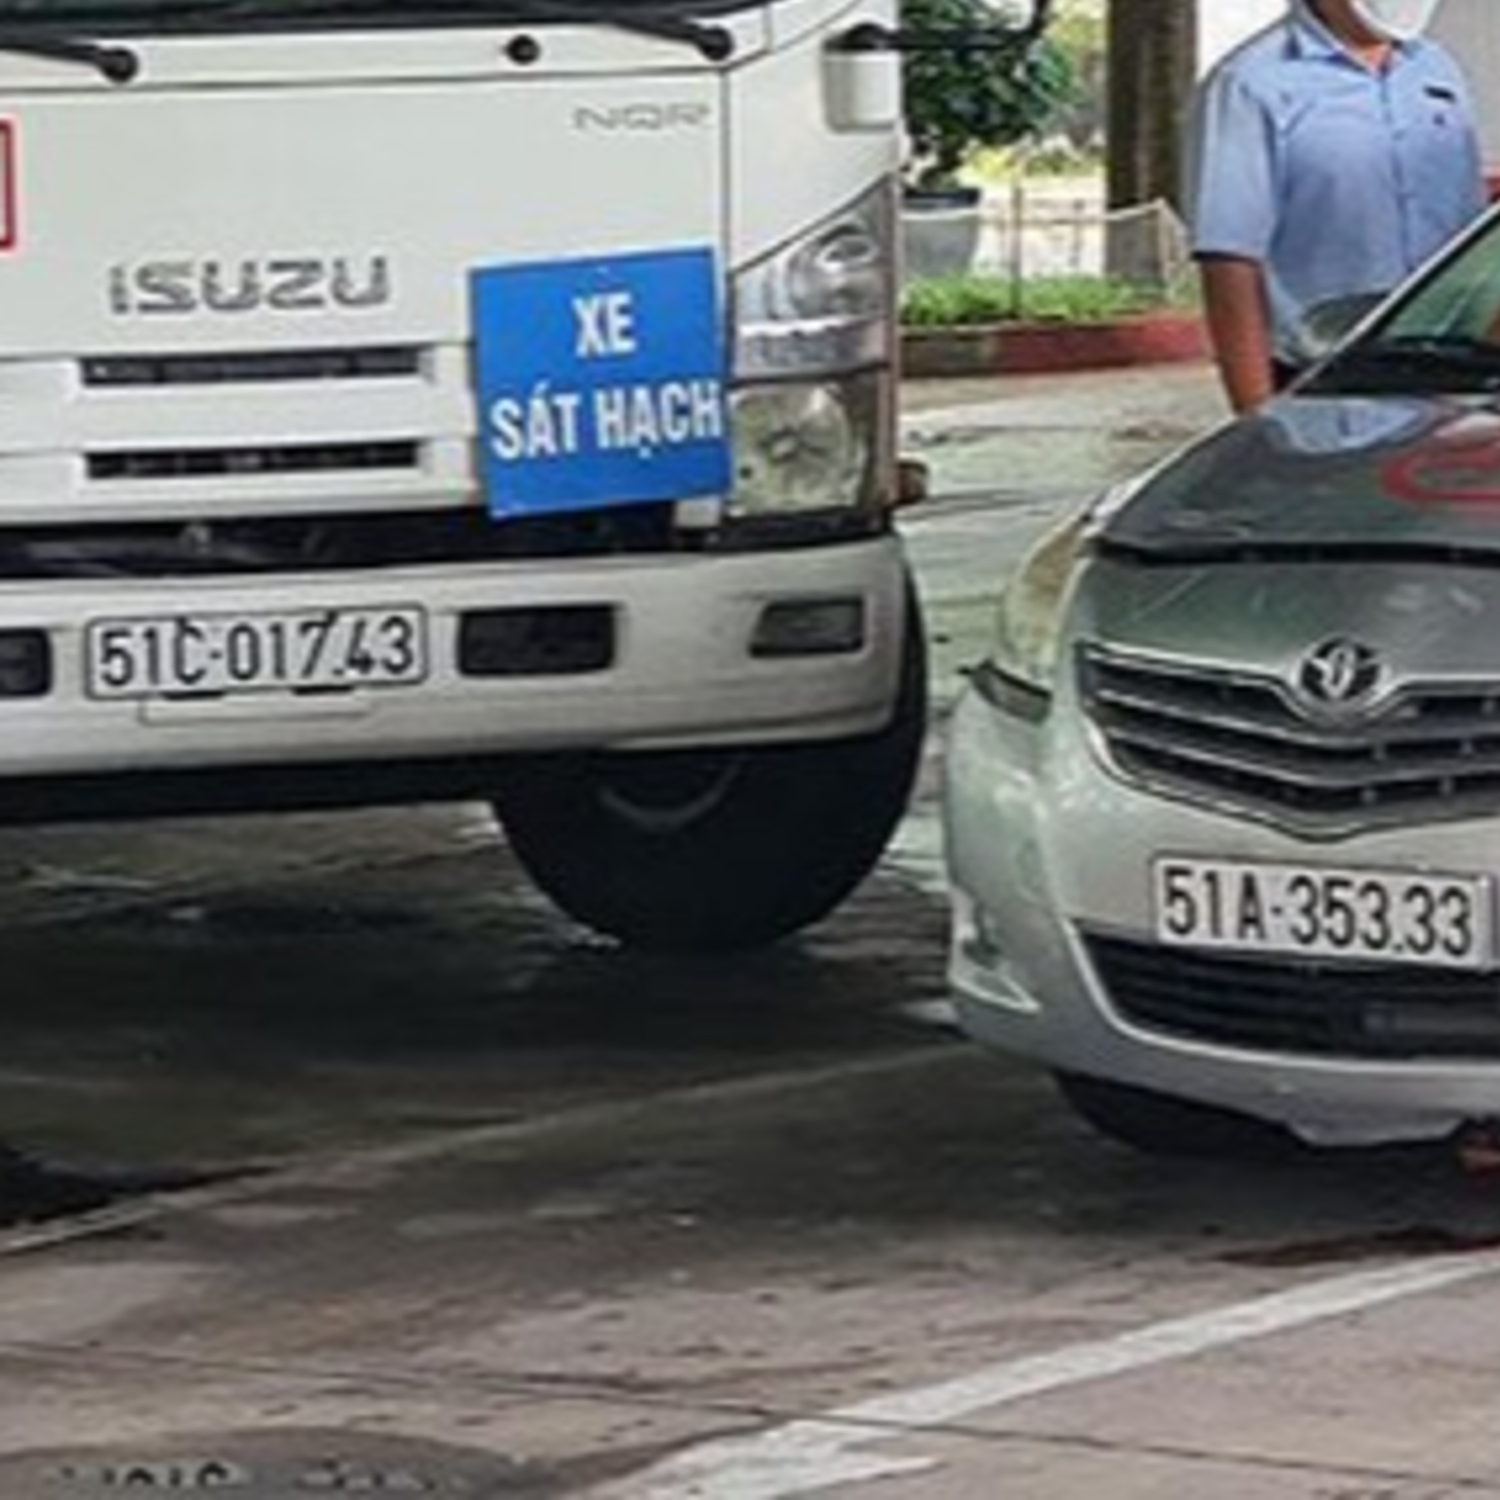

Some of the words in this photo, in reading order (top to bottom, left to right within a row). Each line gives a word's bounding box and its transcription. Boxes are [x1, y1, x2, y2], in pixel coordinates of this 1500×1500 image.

[108, 257, 391, 314] ISUZU
[571, 292, 636, 359] XE
[491, 380, 581, 461] SÁT
[594, 380, 723, 460] HẠCH
[100, 614, 414, 686] 51C-017.43
[1164, 866, 1473, 957] 51A-353.33
